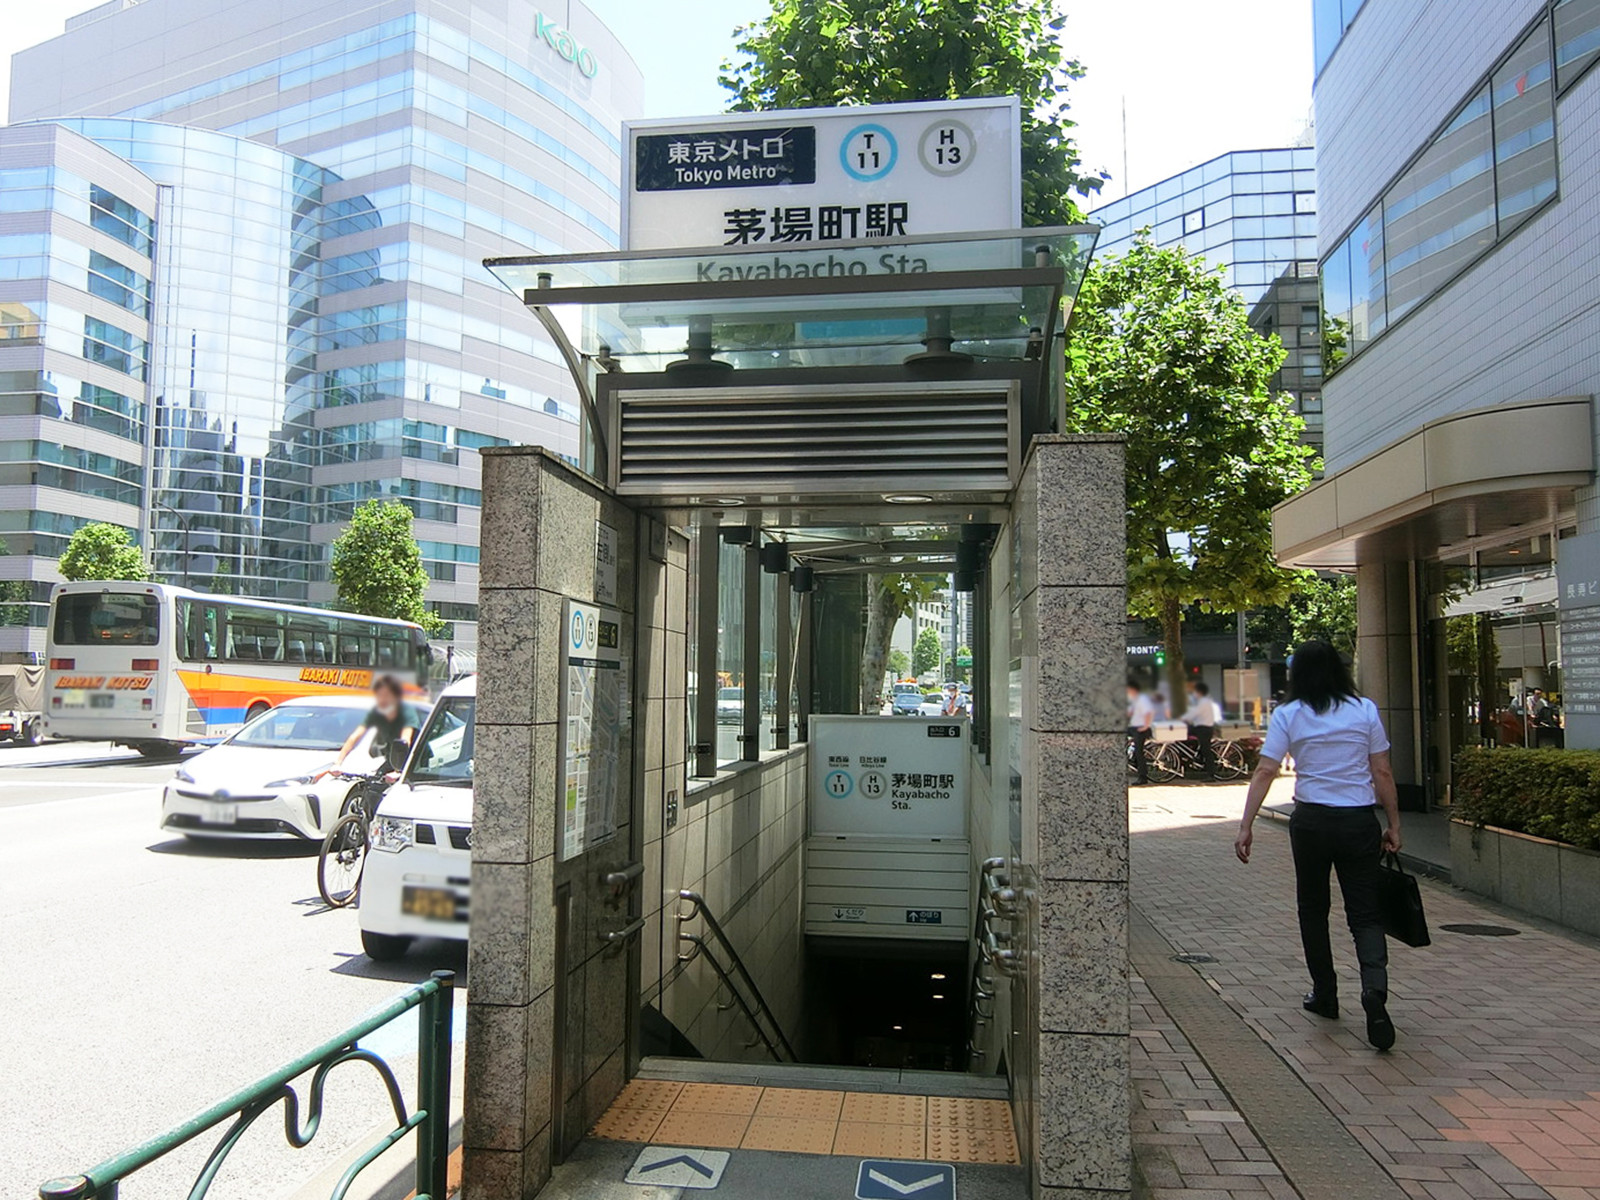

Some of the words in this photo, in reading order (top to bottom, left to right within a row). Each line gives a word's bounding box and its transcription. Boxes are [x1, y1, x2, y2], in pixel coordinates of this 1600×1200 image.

[862, 133, 874, 150] T
[939, 129, 954, 146] H
[667, 136, 785, 165] 東京メトロ
[935, 147, 962, 166] 13
[857, 151, 881, 170] 11
[675, 166, 723, 184] Tokyo
[727, 164, 777, 181] Metro
[724, 201, 909, 247] 茅場町駅
[54, 676, 106, 690] IBARAKI
[106, 676, 153, 691] KOTSU
[299, 667, 340, 685] IBARAKI
[949, 727, 955, 736] 6
[837, 775, 842, 783] T
[870, 775, 877, 783] H
[892, 774, 954, 788] 茅場町駅
[833, 784, 845, 793] 11
[867, 784, 880, 793] 13
[892, 790, 950, 800] Kayabacho
[892, 801, 911, 809] Sta.
